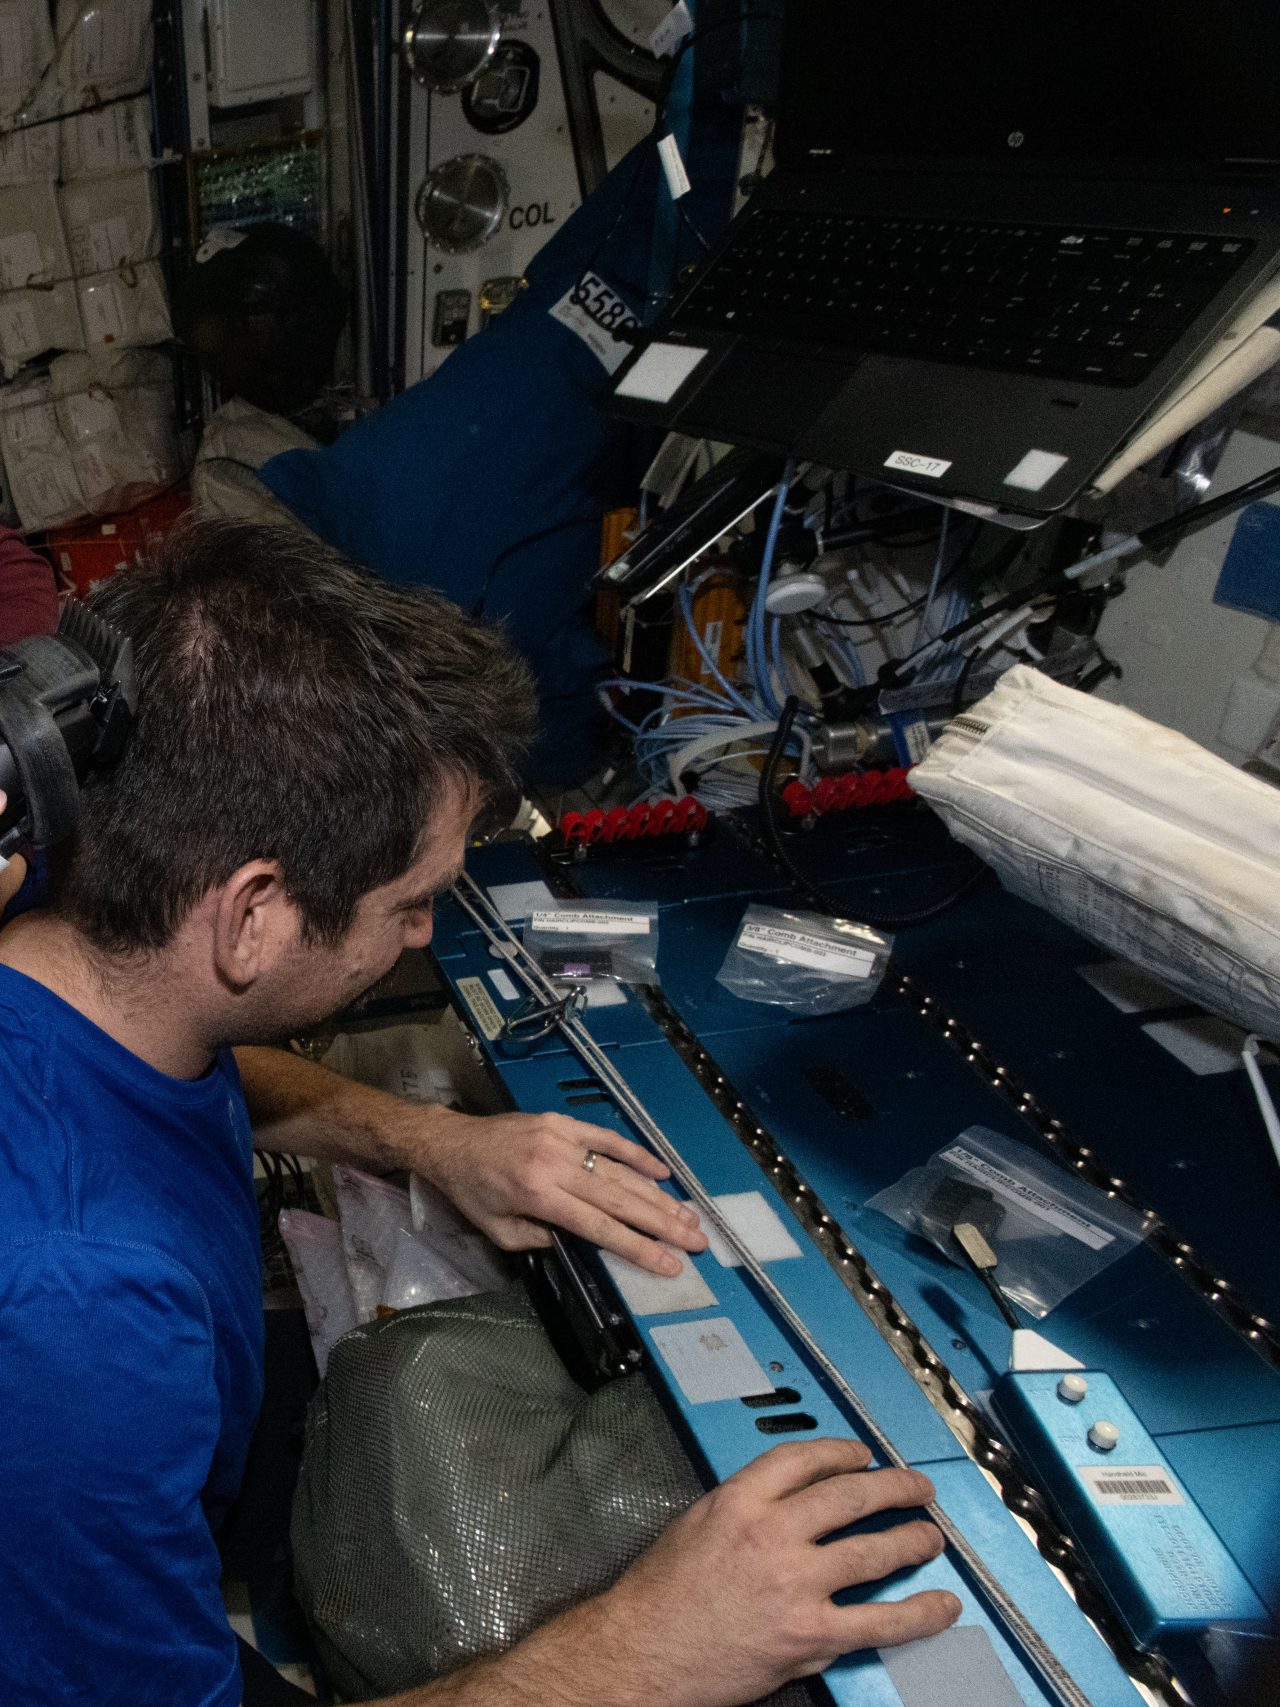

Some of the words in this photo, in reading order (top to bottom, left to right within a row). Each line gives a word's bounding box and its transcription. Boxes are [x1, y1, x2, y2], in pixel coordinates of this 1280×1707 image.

[509, 202, 555, 230] COL
[895, 455, 943, 472] SSC-17
[582, 913, 633, 922] Attachment
[747, 925, 766, 933] 3/8"
[769, 928, 797, 940] Comb
[799, 936, 857, 957] Attachment
[957, 1148, 979, 1162] 1/8"
[980, 1161, 1016, 1186] Comb
[1019, 1185, 1092, 1228] Attachment
[1101, 1470, 1134, 1478] Handheld
